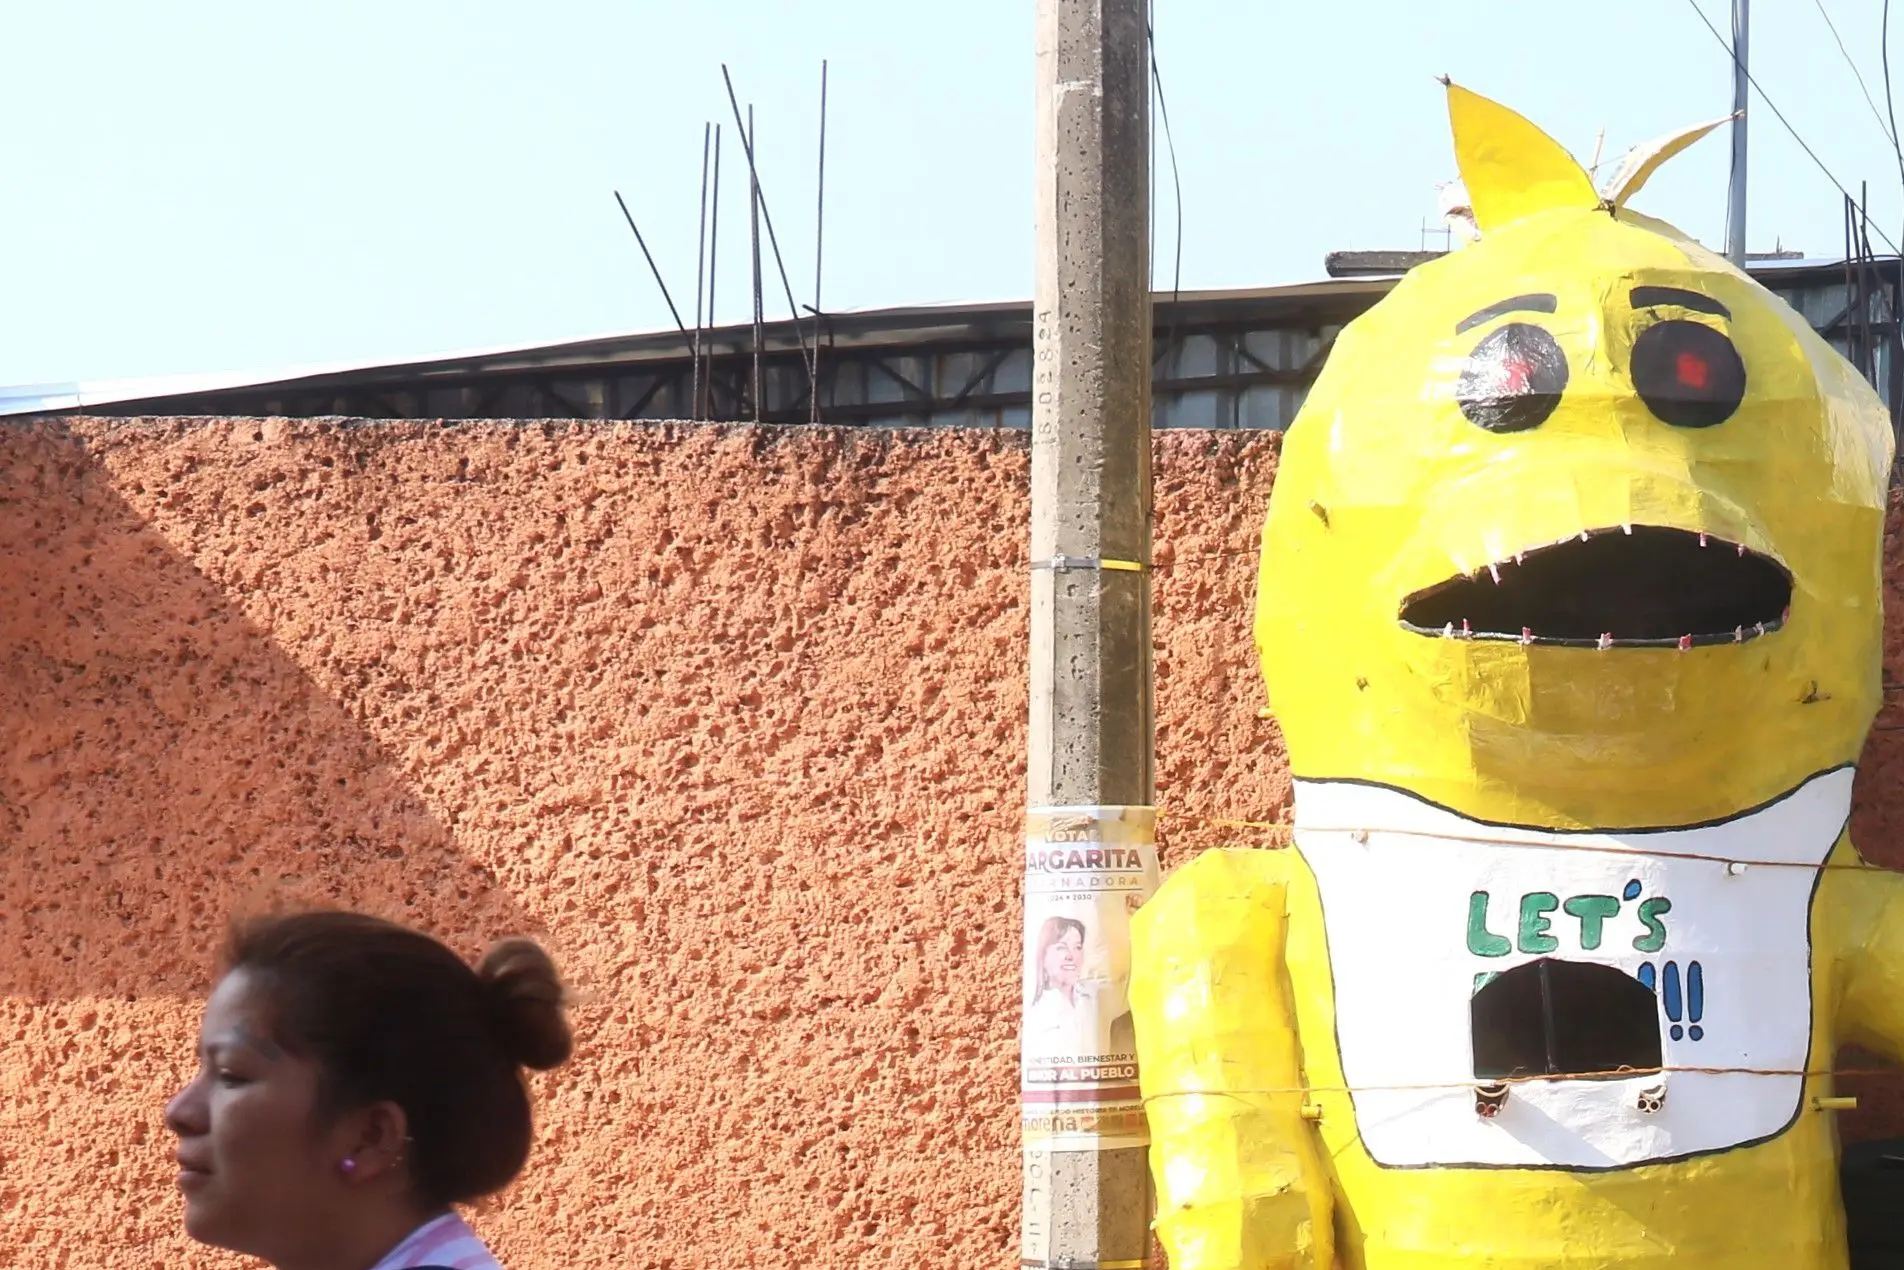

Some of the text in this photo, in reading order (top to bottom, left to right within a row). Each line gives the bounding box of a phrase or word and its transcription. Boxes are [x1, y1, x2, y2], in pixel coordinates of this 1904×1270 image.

[1028, 848, 1142, 872] ARGARITA
[1467, 879, 1672, 957] LET'S
[1077, 1054, 1127, 1064] BIENESTAR
[1127, 1053, 1136, 1061] Y
[1059, 1069, 1078, 1081] AL
[1080, 1066, 1135, 1080] PUEBLO
[1022, 1116, 1078, 1132] morena
